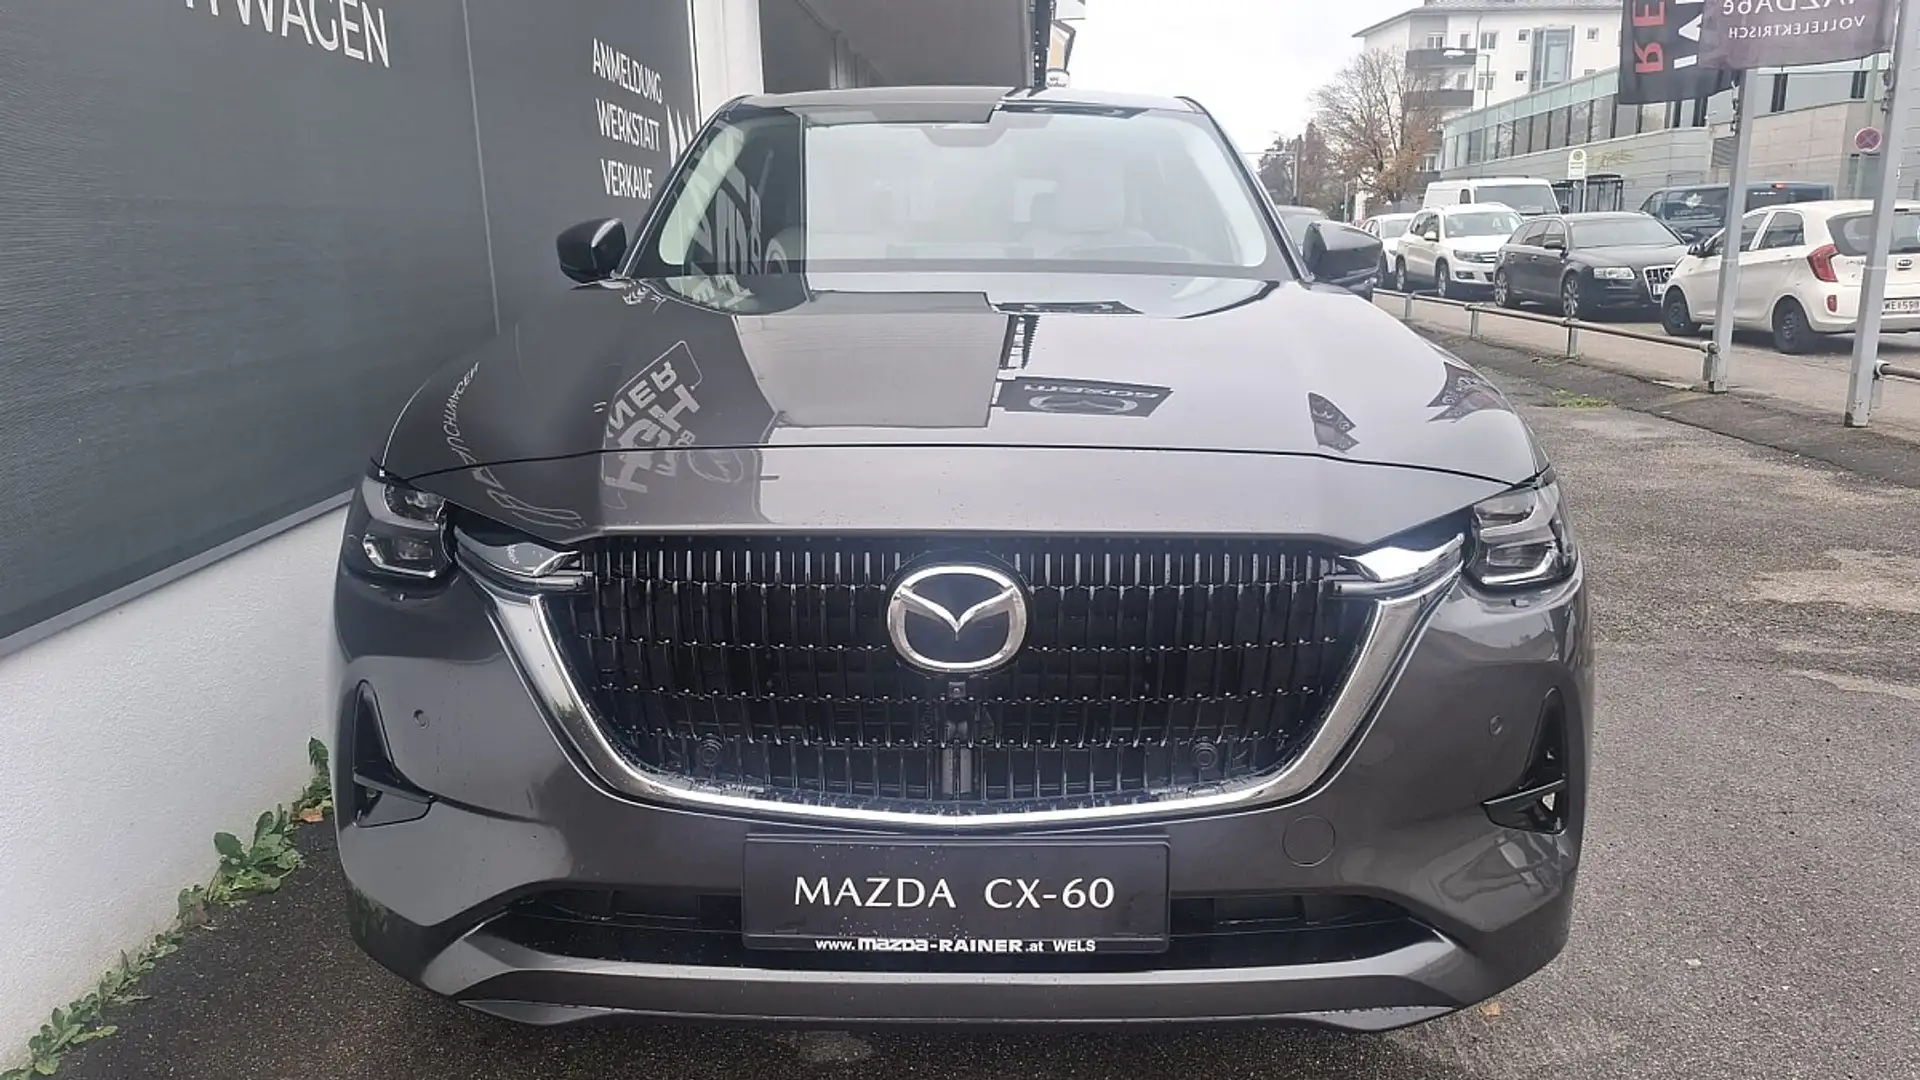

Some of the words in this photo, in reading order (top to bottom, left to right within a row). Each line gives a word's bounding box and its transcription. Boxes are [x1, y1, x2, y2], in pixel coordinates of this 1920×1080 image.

[186, 0, 390, 68] WAGEN
[593, 37, 663, 105] ANMELDUNG
[595, 98, 661, 152] WERKSTATT
[600, 158, 653, 200] VERKAUF
[794, 876, 956, 908] MAZDA
[984, 878, 1115, 909] CX-60
[1053, 940, 1096, 952] WELS
